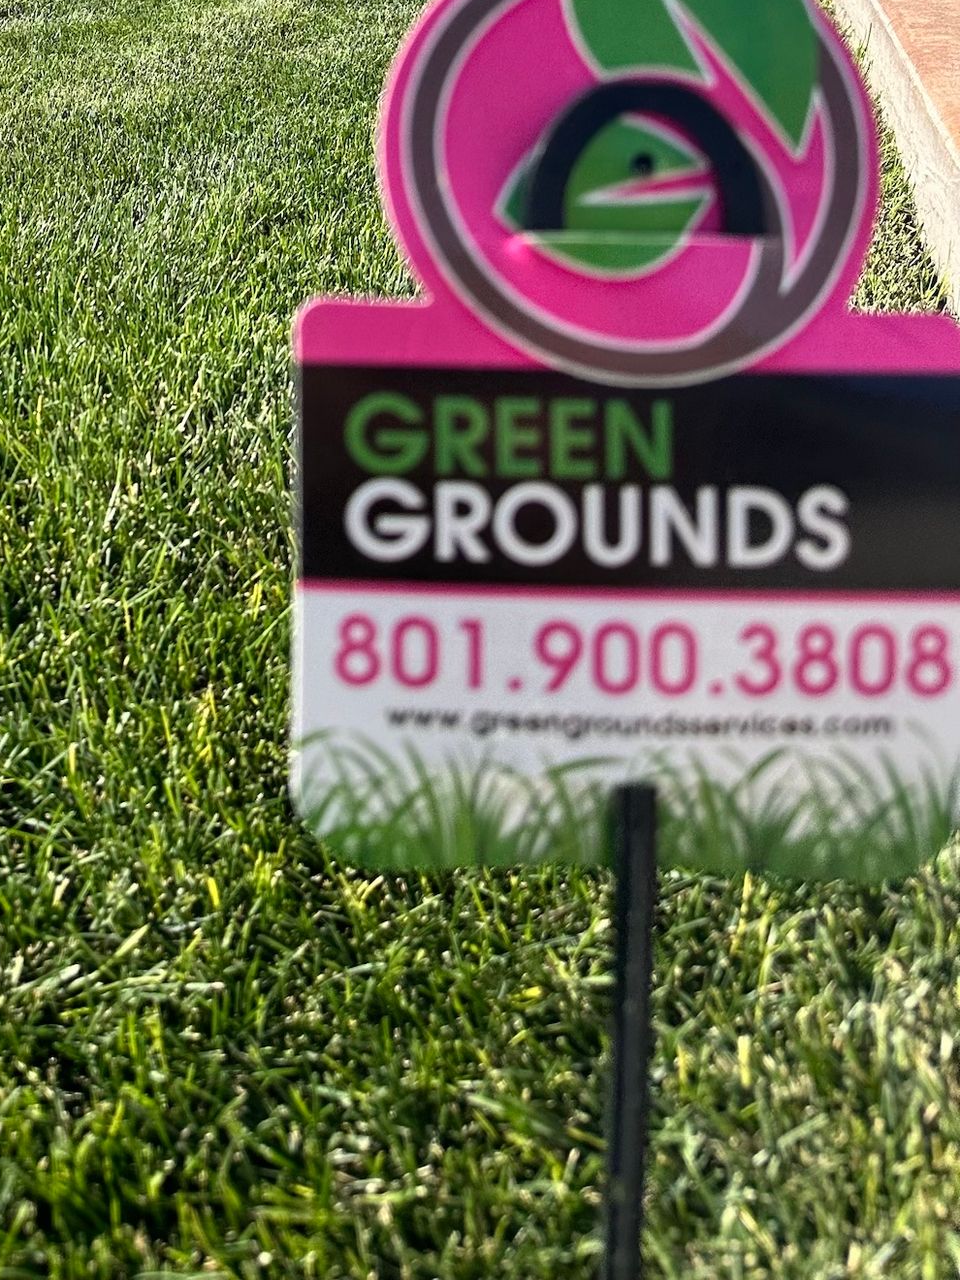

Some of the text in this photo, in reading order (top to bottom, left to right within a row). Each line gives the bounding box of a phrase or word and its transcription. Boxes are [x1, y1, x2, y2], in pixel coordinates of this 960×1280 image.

[345, 393, 674, 479] GREEN
[344, 476, 851, 569] GROUNDS
[334, 612, 953, 698] 801.900.3808
